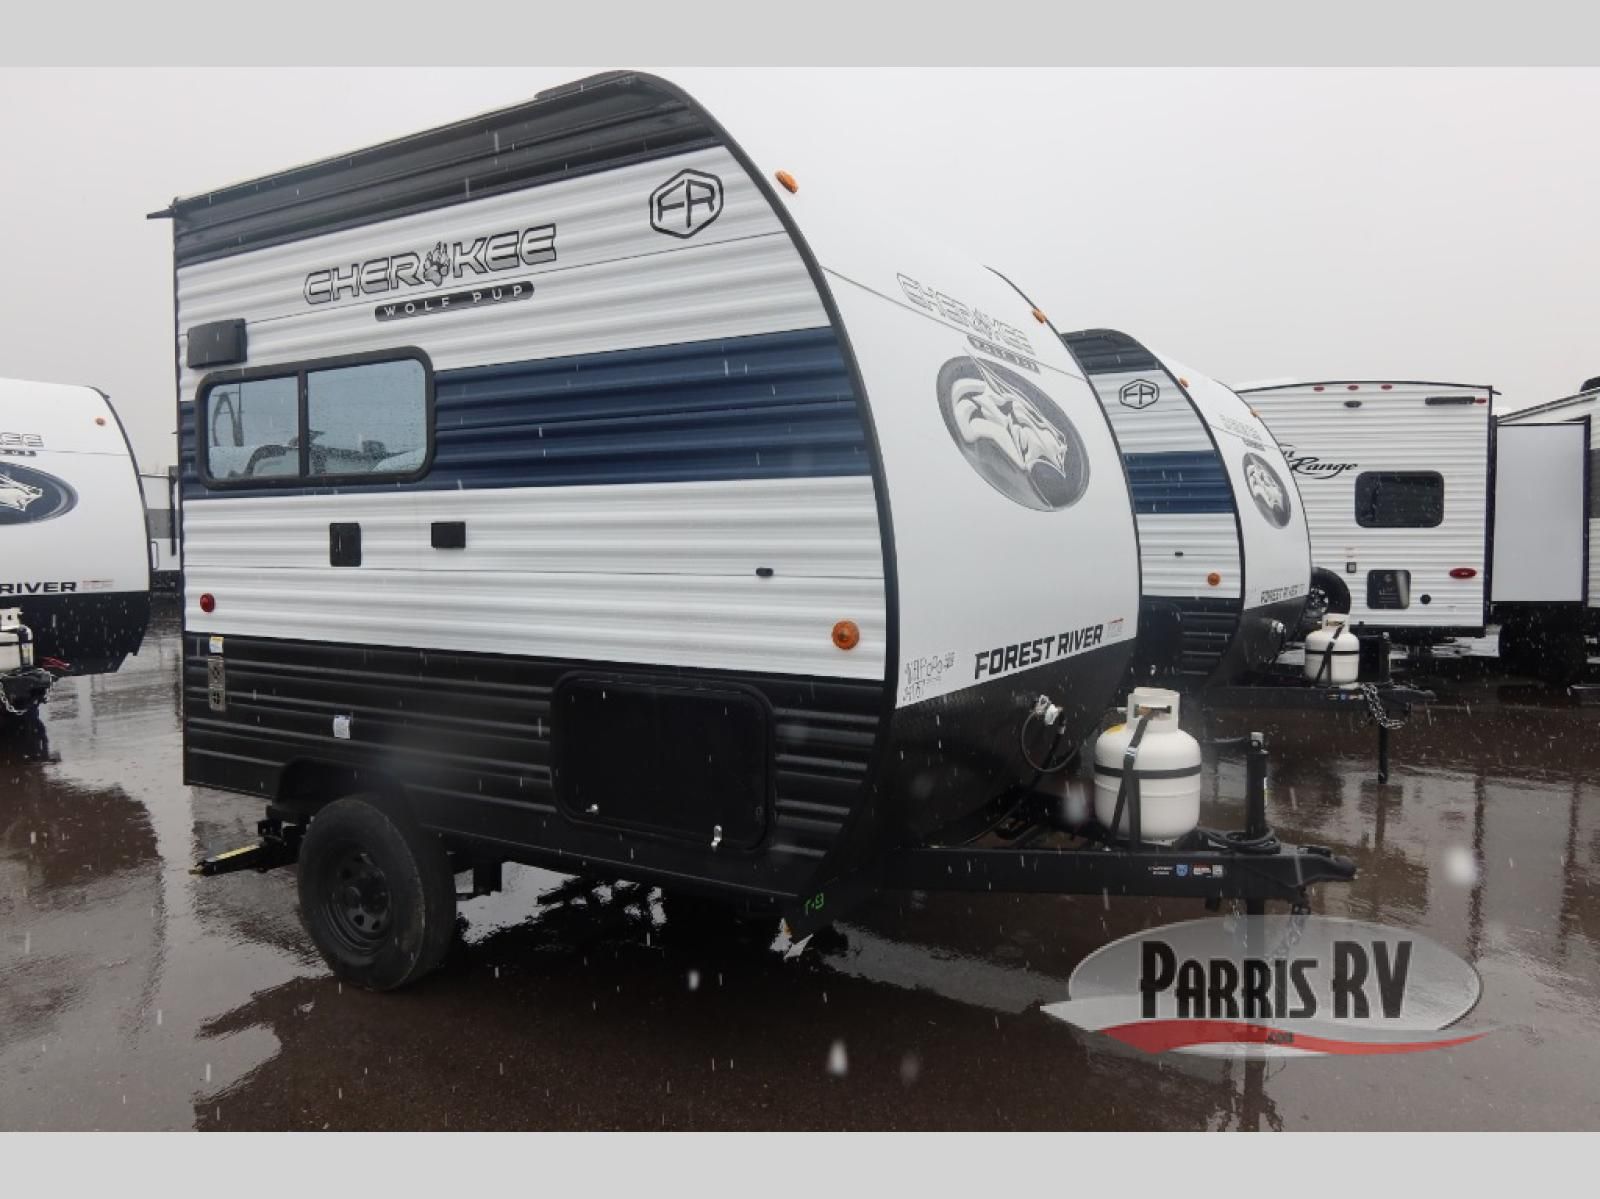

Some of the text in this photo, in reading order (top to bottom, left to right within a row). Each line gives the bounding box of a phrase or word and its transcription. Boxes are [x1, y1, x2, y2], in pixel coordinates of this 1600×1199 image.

[383, 286, 524, 317] WOLF PUP
[0, 582, 77, 594] RIVER
[975, 636, 1056, 680] FOREST
[1057, 624, 1104, 657] RIVER
